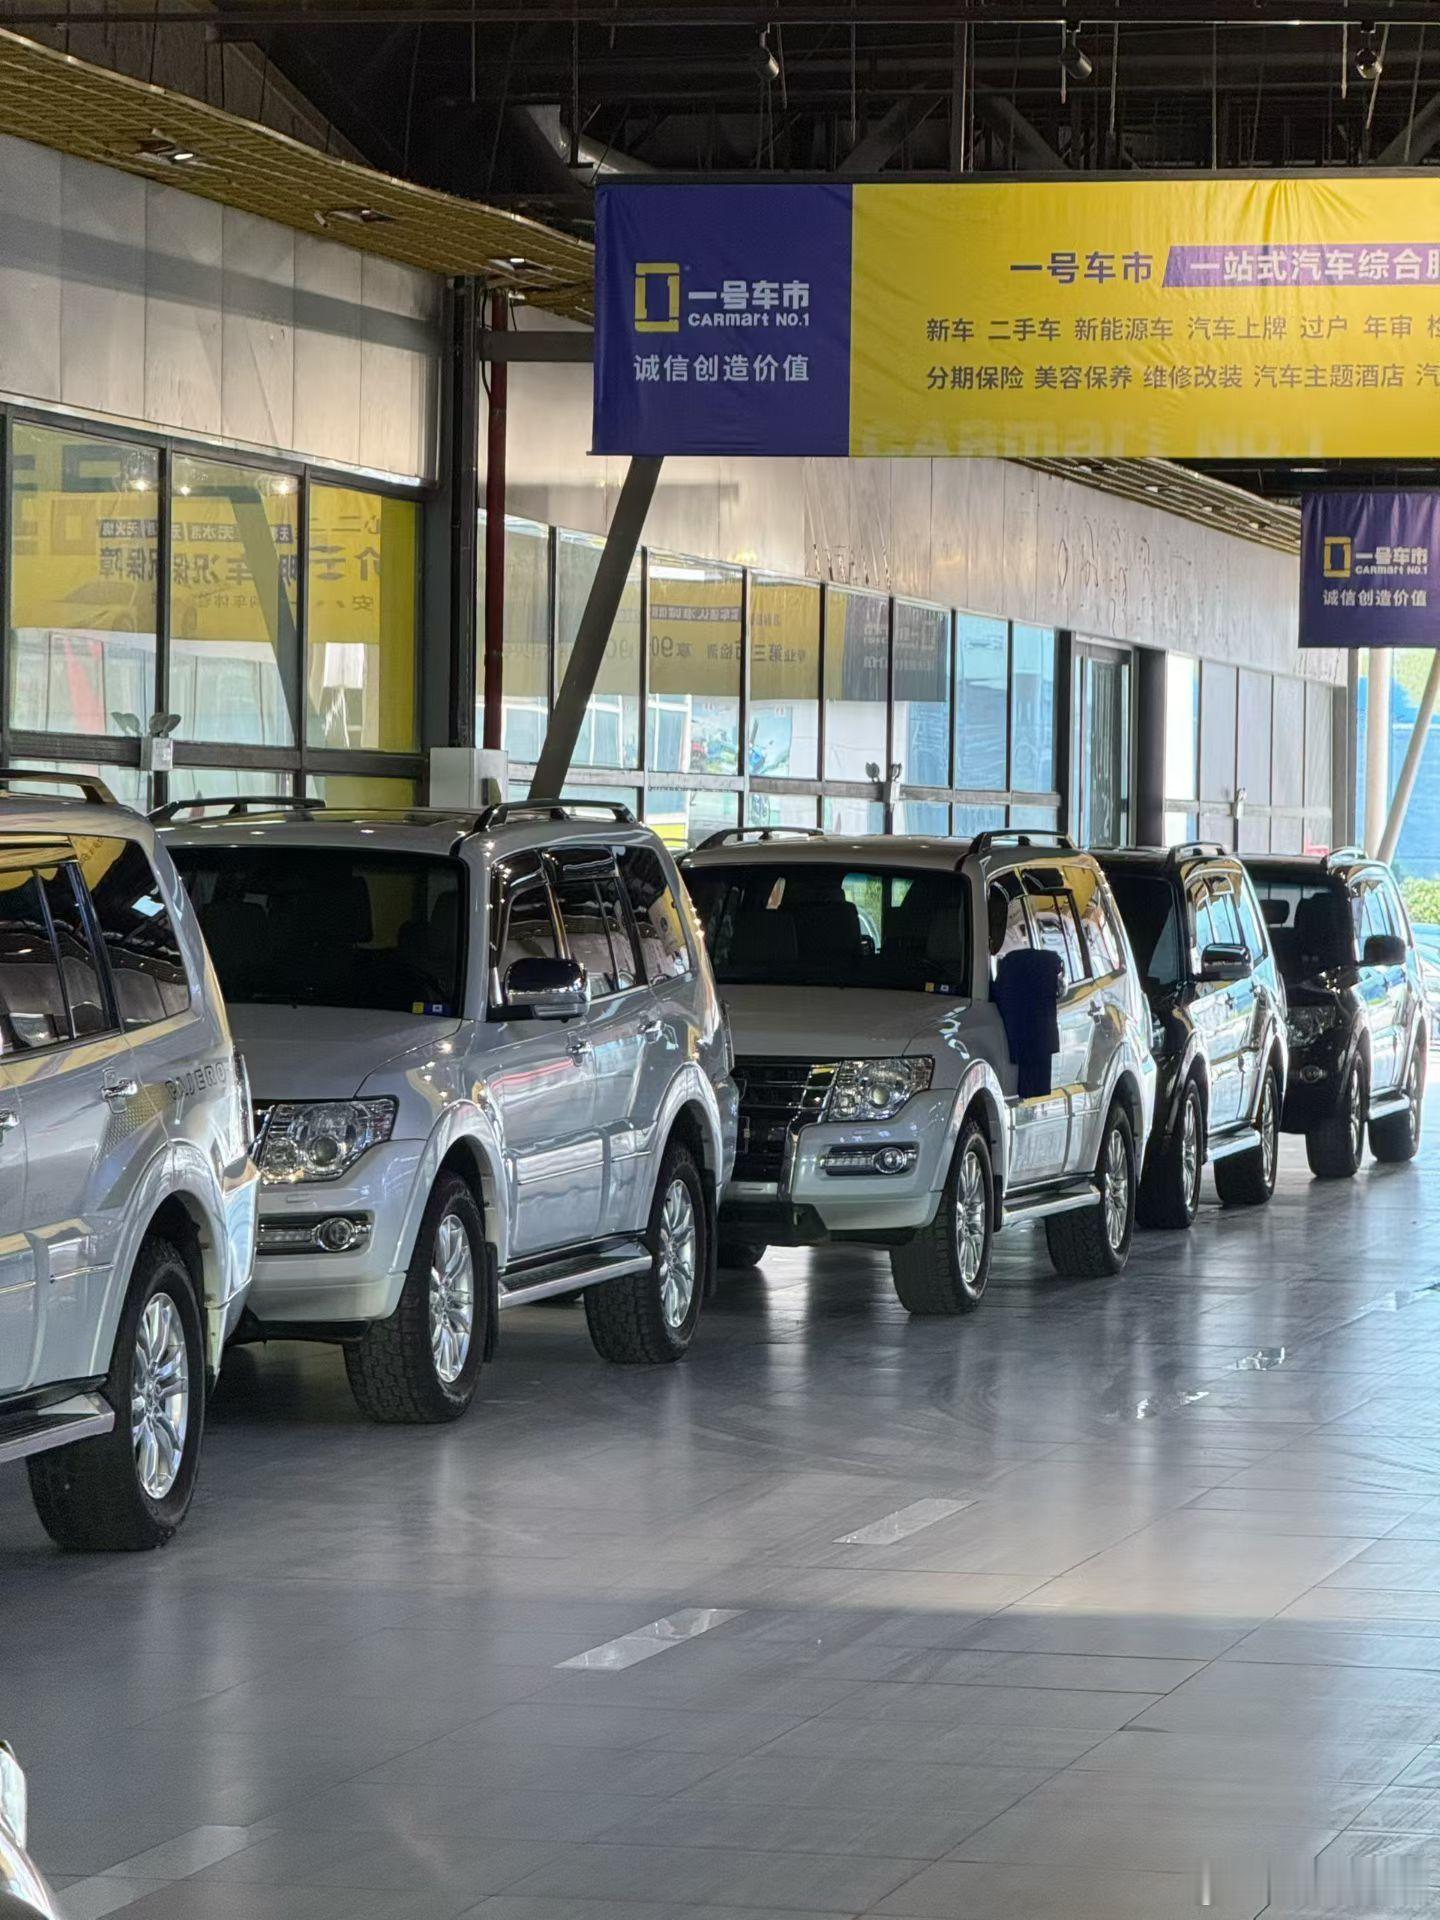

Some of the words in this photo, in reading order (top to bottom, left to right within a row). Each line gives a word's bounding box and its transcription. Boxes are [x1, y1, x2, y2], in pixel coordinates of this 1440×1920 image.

[1010, 251, 1153, 285] 一号车市
[688, 280, 810, 310] 一号车市
[688, 312, 769, 327] CARmart
[776, 312, 810, 327] NO.1
[926, 317, 975, 343] 新车
[988, 317, 1062, 342] 二手车
[1074, 317, 1174, 341] 新能源车
[1187, 316, 1287, 341] 汽车上牌
[1300, 315, 1348, 341] 过户
[1363, 314, 1413, 340] 年审
[634, 354, 810, 382] 诚信创造价值
[926, 364, 1024, 391] 分期保险
[1034, 364, 1133, 390] 美容保养
[1143, 364, 1243, 389] 维修改装
[1254, 363, 1405, 389] 汽车主题酒店
[1355, 546, 1428, 565] 一号车市
[1322, 588, 1428, 607] 诚信创造价值
[165, 1062, 227, 1101] PAJERO
